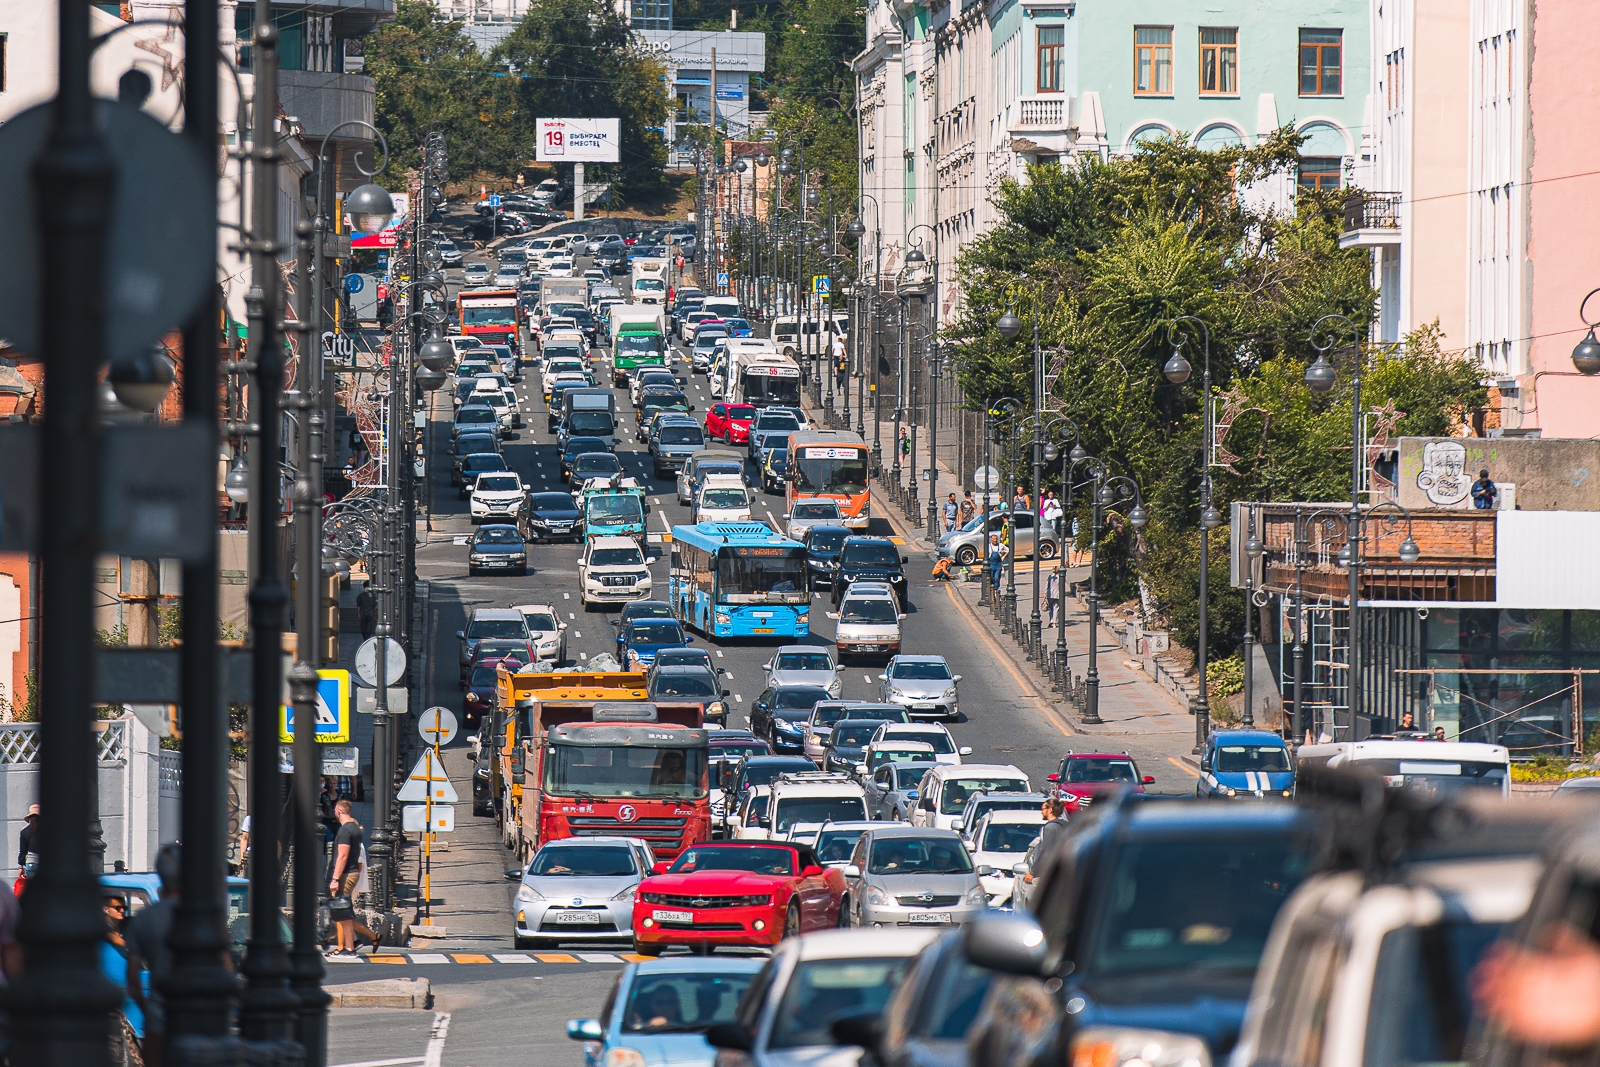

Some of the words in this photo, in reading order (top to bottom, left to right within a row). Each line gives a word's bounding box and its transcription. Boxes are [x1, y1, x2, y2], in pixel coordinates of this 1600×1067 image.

[546, 131, 563, 146] 19
[321, 331, 354, 362] City
[769, 367, 778, 375] 55
